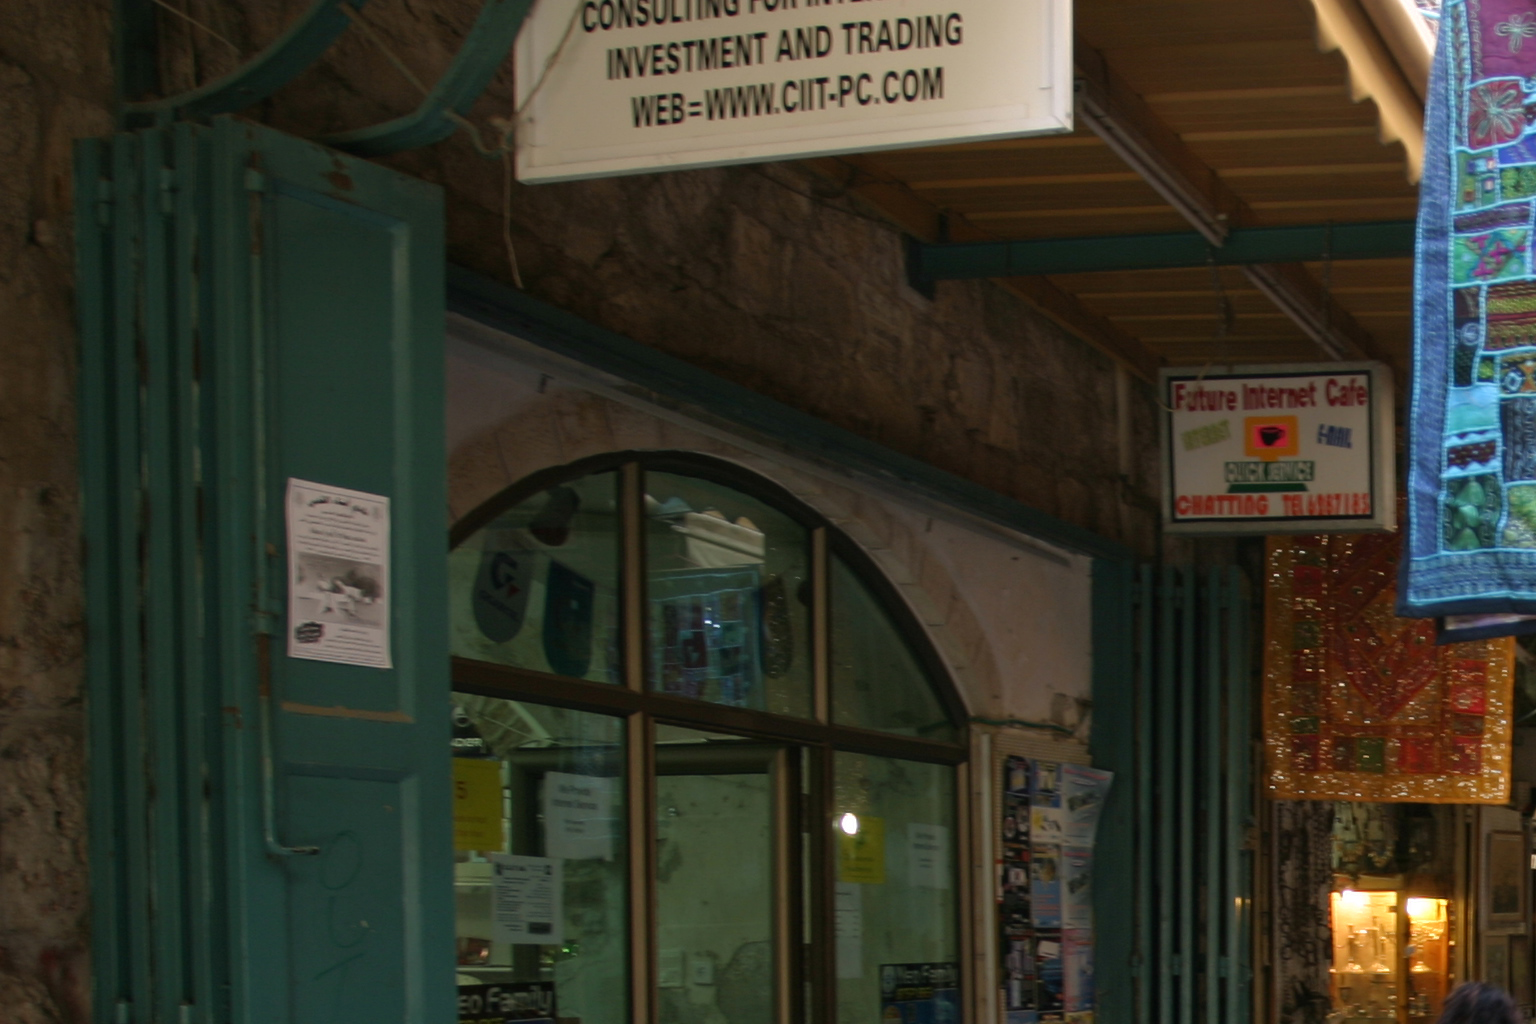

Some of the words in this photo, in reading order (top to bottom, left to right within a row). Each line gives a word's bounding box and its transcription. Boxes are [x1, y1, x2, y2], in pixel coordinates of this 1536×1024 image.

[606, 32, 767, 80] INVESTMENT
[775, 26, 833, 62] AND
[841, 12, 963, 55] TRADING
[630, 66, 945, 128] WEB=WWW.CIIT-PC.COM
[1174, 383, 1237, 411] Future
[1242, 380, 1317, 410] Internet
[1325, 378, 1368, 407] Cafe
[1226, 462, 1266, 482] QUICK
[1267, 461, 1313, 482] SERVICE
[1175, 494, 1269, 516] CHATTING
[486, 984, 553, 1016] Family
